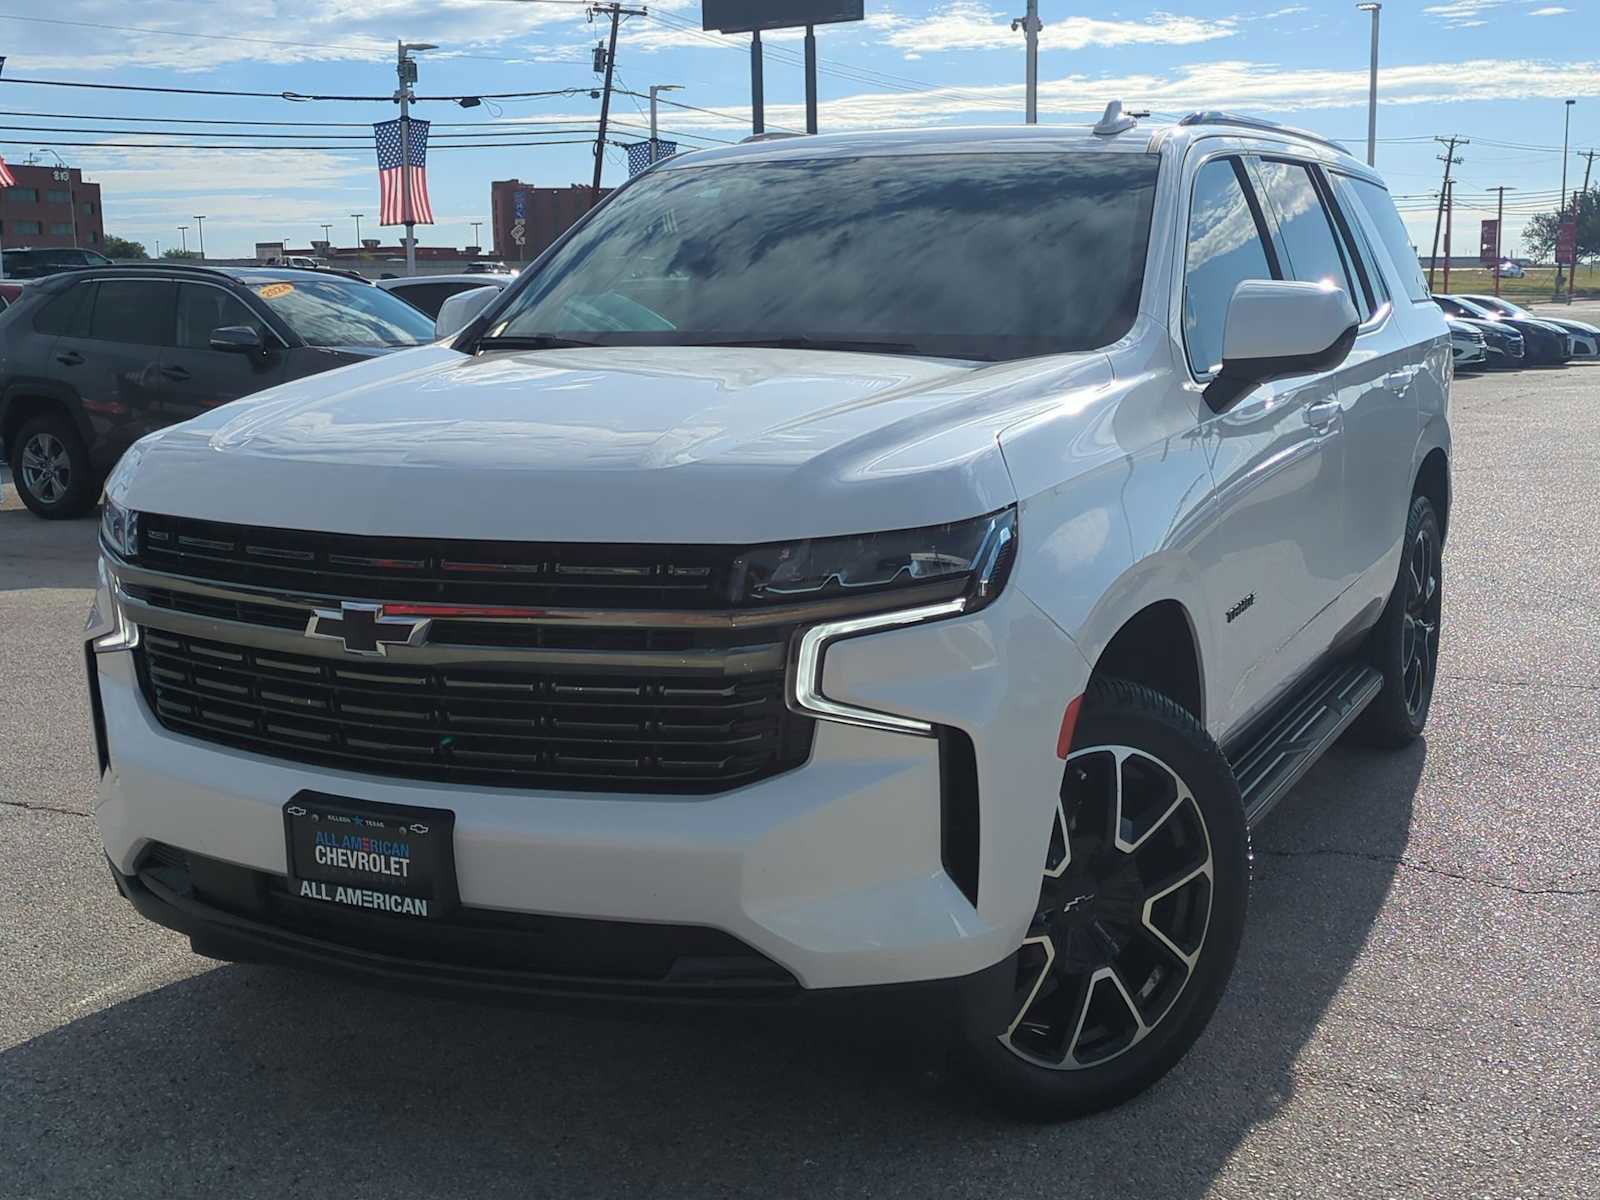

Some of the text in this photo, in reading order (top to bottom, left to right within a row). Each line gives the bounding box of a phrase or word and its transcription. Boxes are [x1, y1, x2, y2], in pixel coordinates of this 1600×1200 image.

[315, 831, 409, 856] ALL AMERICAN
[315, 845, 410, 877] CHEVROLET
[300, 880, 427, 916] ALL AMERICAN
